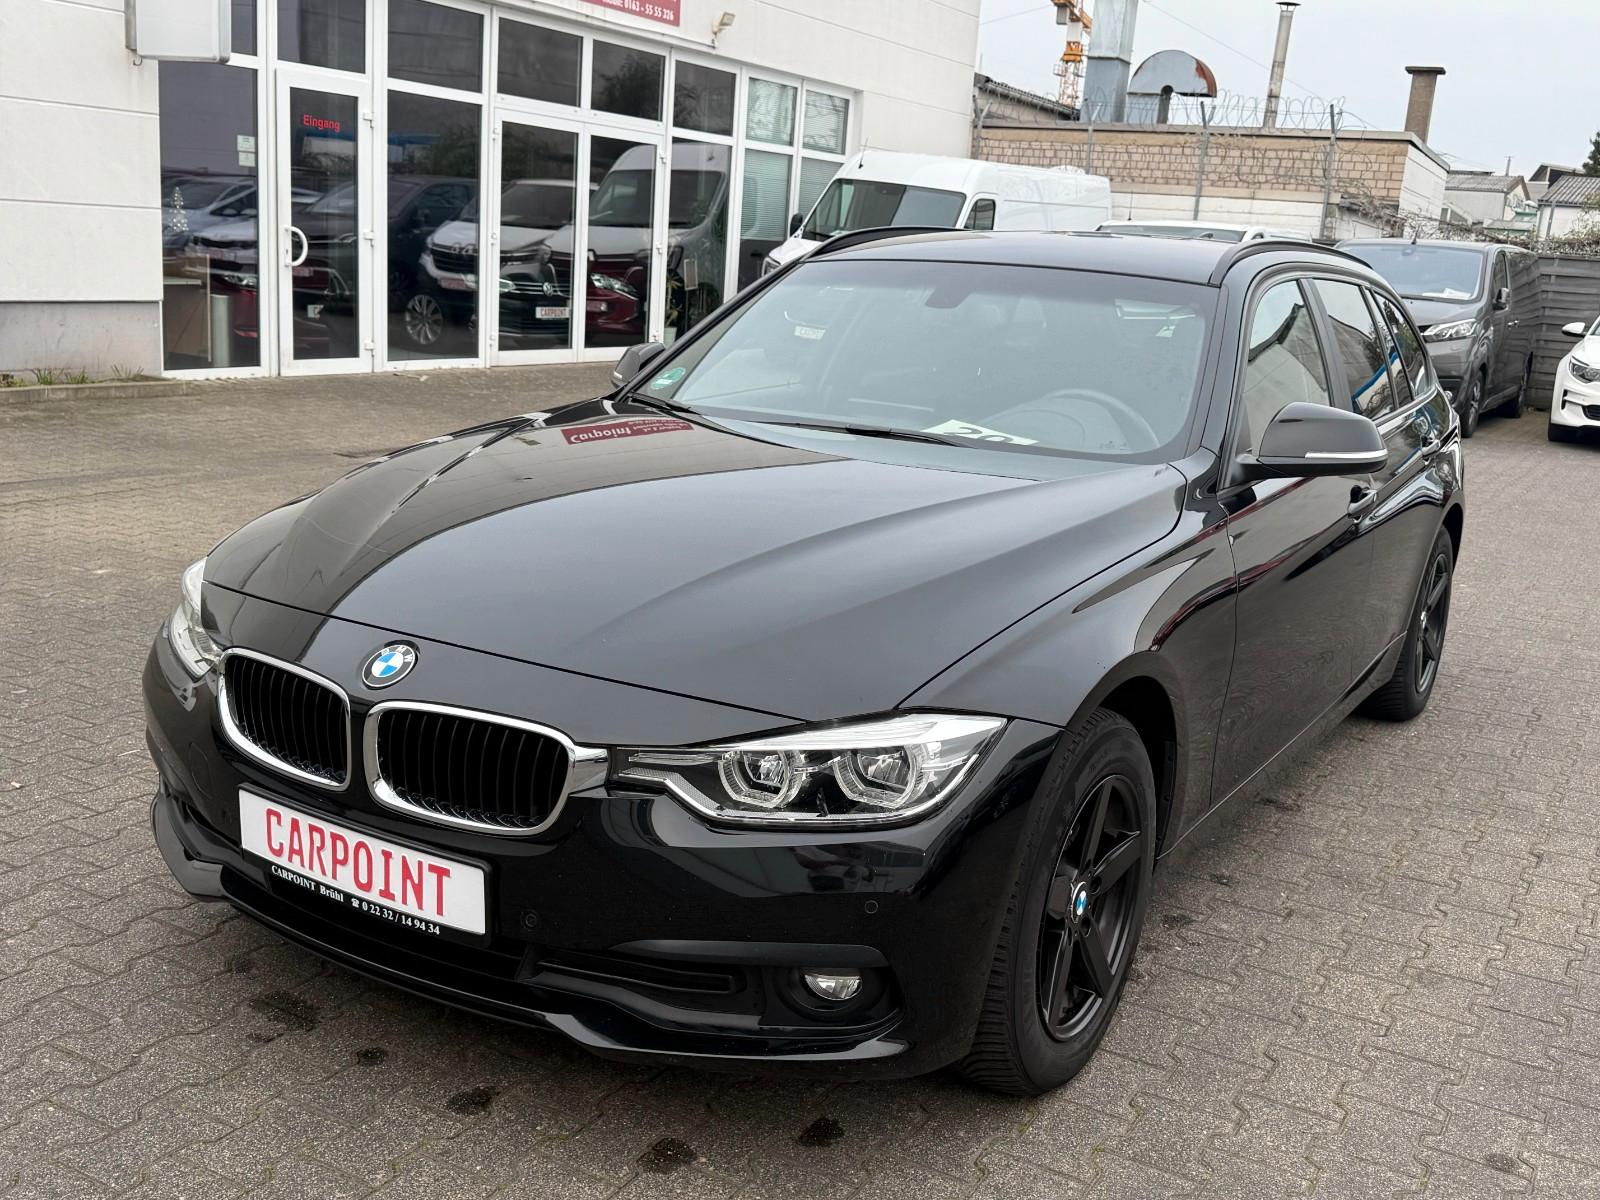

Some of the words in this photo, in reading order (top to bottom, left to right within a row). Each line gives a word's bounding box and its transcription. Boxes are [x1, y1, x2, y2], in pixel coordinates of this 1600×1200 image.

[303, 114, 341, 133] Eingang
[266, 808, 450, 916] CARPOINT
[271, 865, 316, 891] CARPOINT
[320, 884, 344, 902] Brühl
[362, 902, 368, 911] 0
[369, 904, 380, 916] 22
[382, 908, 394, 920] 32
[394, 913, 399, 922] /
[401, 915, 412, 926] 14
[413, 919, 426, 931] 94
[427, 923, 440, 935] 34
